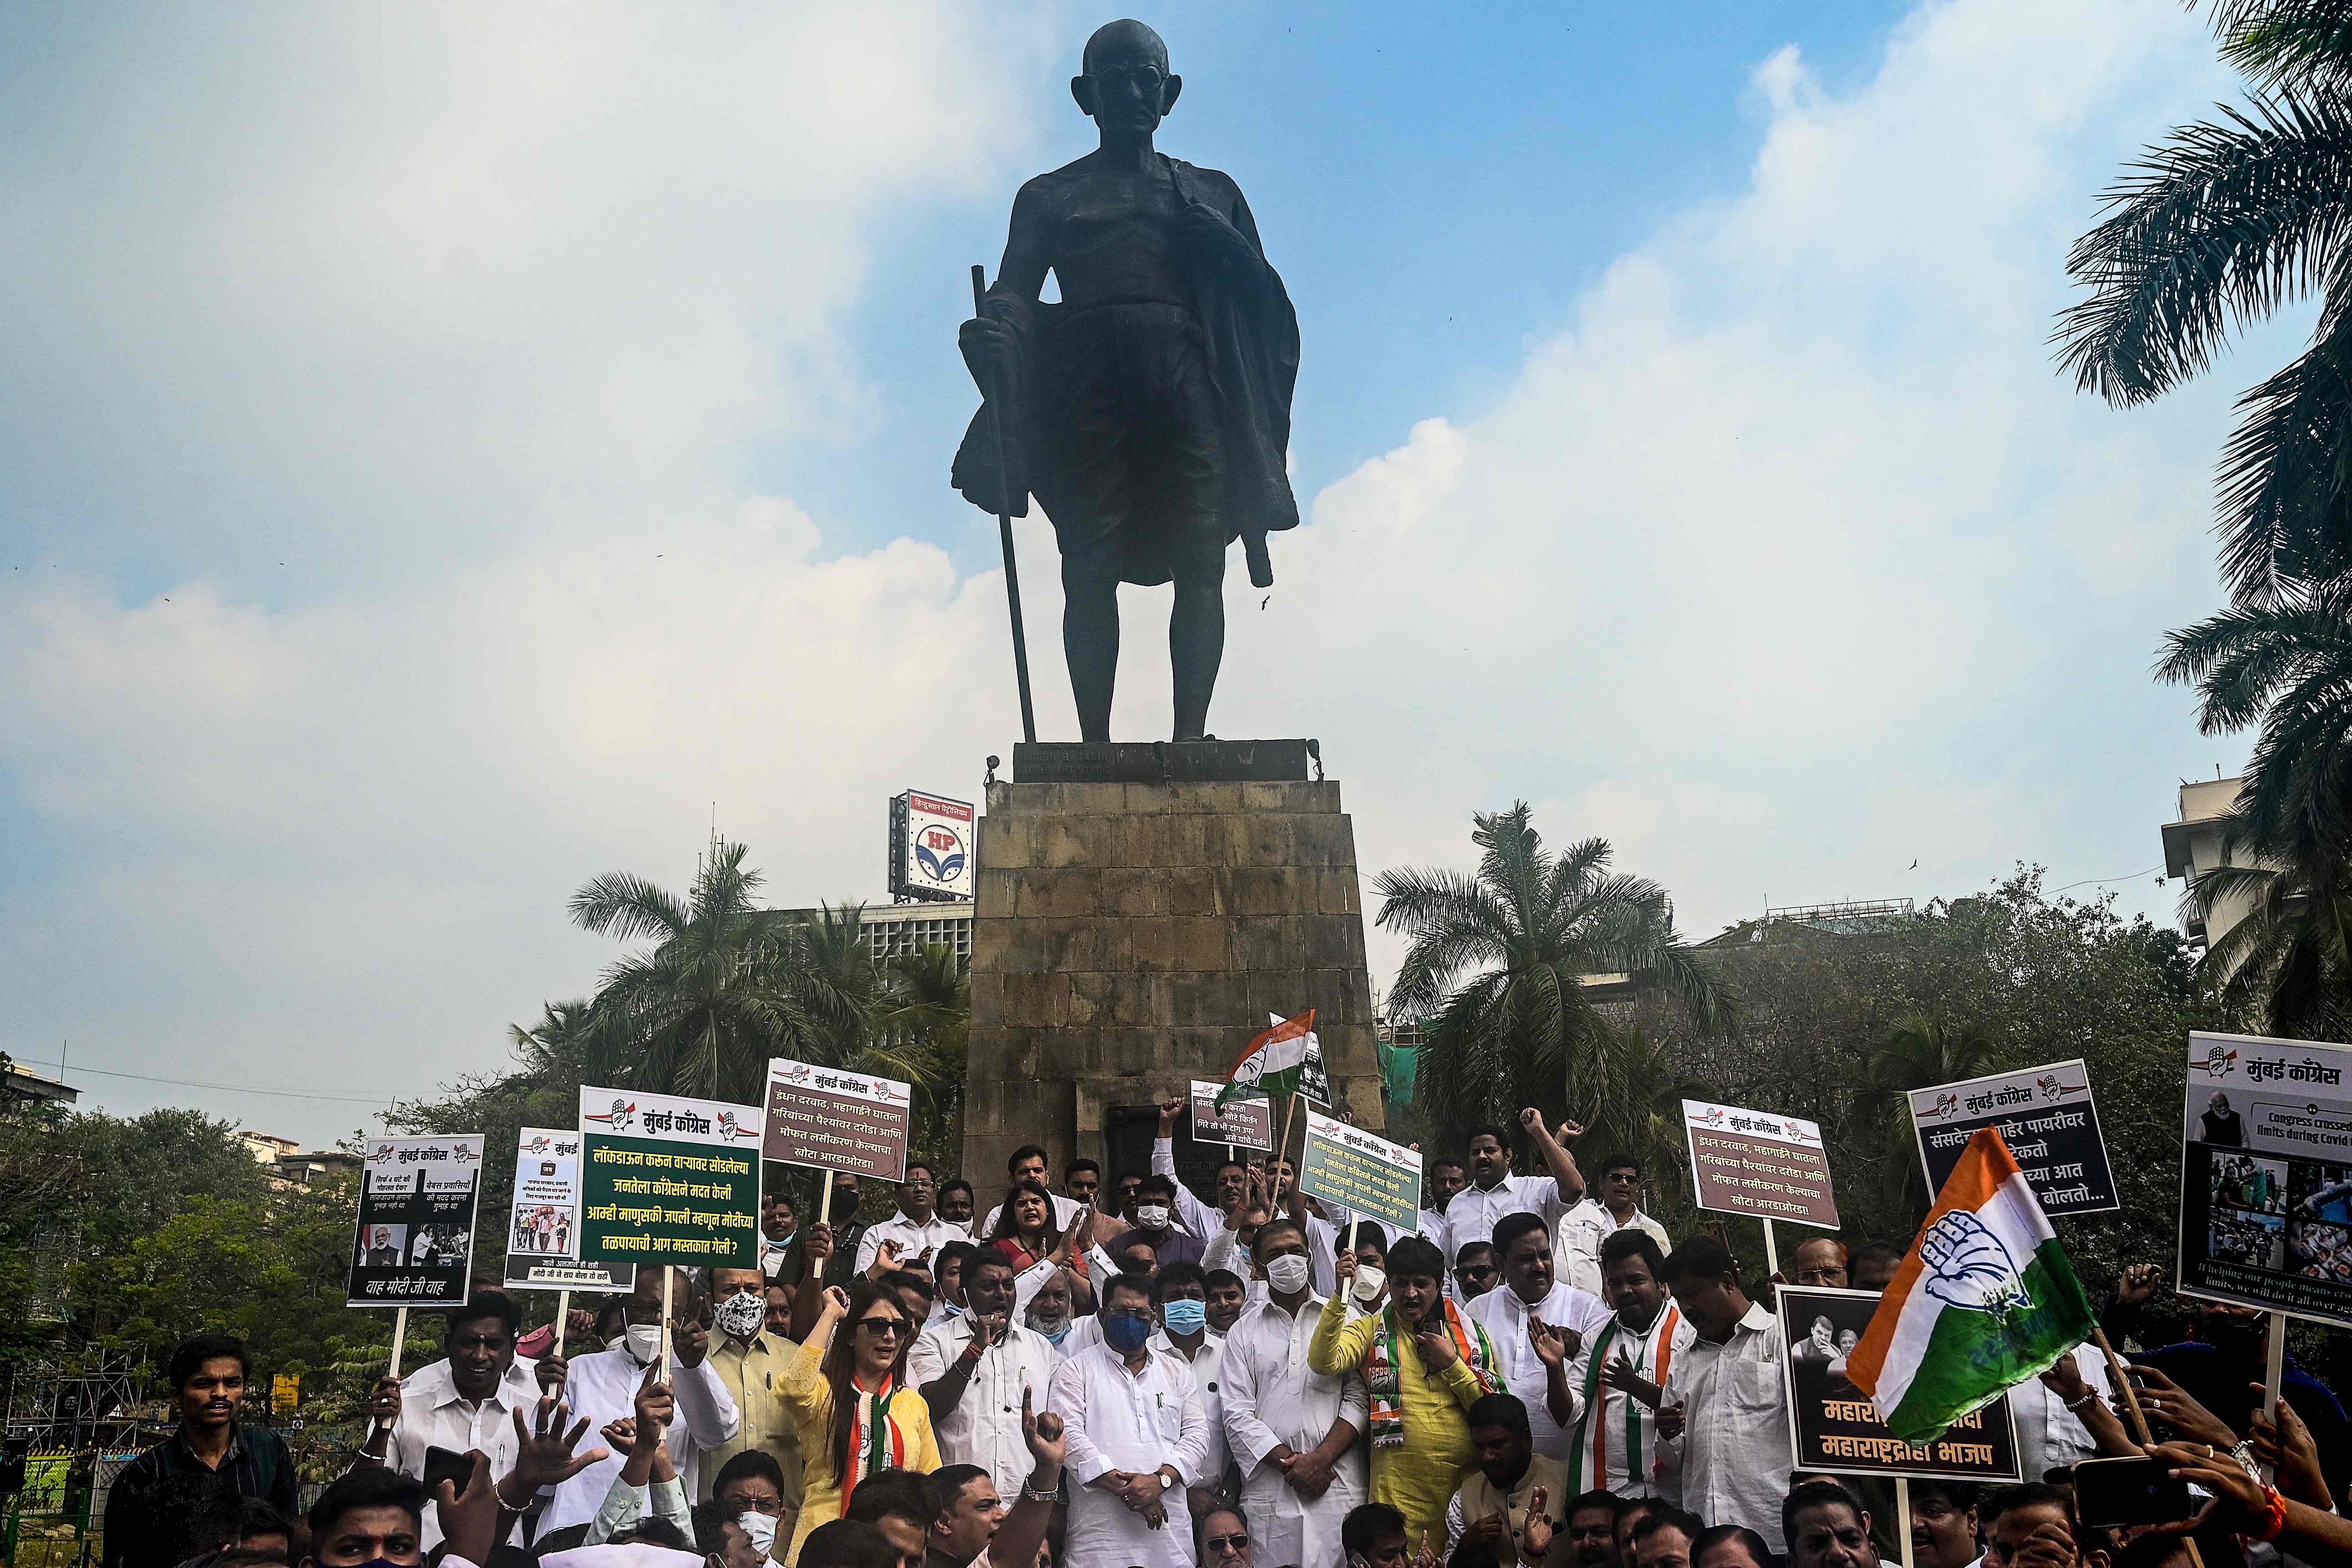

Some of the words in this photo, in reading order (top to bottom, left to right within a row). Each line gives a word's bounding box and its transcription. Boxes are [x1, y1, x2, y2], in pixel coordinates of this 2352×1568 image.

[915, 798, 940, 811] हिन्दुस्तान
[942, 804, 968, 817] पेट्रोलियम
[928, 832, 955, 851] HP
[2246, 1057, 2286, 1082] मुंबई
[2287, 1058, 2342, 1085] काँग्रेस
[815, 1074, 838, 1088] मुंबई
[840, 1077, 868, 1094] काँग्रेस
[776, 1089, 796, 1103] इंधन
[799, 1095, 830, 1110] दरवाढ,
[832, 1101, 871, 1116] महागाईने
[873, 1110, 902, 1123] घातला
[1229, 1104, 1246, 1113] करतो
[1964, 1090, 1994, 1115] मुंबई
[1995, 1085, 2032, 1107] काँग्रेस
[643, 1109, 672, 1134] मुंबई
[674, 1109, 710, 1134] काँग्रेस
[772, 1107, 814, 1124] गरिबांच्या
[816, 1113, 851, 1130] पैश्यांवर
[853, 1122, 877, 1134] दरोडा
[879, 1128, 902, 1140] आणि
[1197, 1119, 1209, 1128] गिरे
[1210, 1121, 1218, 1129] तो
[1220, 1122, 1227, 1131] भी
[1229, 1124, 1241, 1132] टांग
[1224, 1112, 1238, 1121] खोटे
[1729, 1115, 1753, 1131] मुंबई
[1754, 1118, 1781, 1135] काँग्रेस
[2027, 1111, 2085, 1133] पायरीवर
[2269, 1113, 2312, 1126] Congress
[780, 1125, 808, 1140] मोफत
[810, 1132, 853, 1147] लसीकरण
[855, 1138, 891, 1155] केल्याचा
[1224, 1134, 1236, 1142] असे
[1238, 1135, 1251, 1144] यांचे
[1252, 1138, 1267, 1147] वर्तन
[1343, 1133, 1362, 1146] मुंबई
[1364, 1140, 1387, 1156] काँग्रेस
[2257, 1124, 2284, 1137] limits
[2287, 1128, 2319, 1144] during
[2321, 1133, 2348, 1146] Covid
[398, 1148, 420, 1164] मुंबई
[420, 1145, 448, 1160] काँग्रेस
[555, 1142, 578, 1156] मुंबई
[593, 1145, 644, 1165] लॉकडाऊन
[645, 1153, 673, 1168] करून
[709, 1155, 749, 1175] सोडलेल्या
[794, 1146, 818, 1159] खोटा
[820, 1151, 874, 1169] आरडाओरडा!
[1312, 1139, 1343, 1157] लॉकडाऊन
[1344, 1151, 1362, 1164] करून
[1698, 1134, 1719, 1147] इंधन
[1720, 1139, 1752, 1154] दरवाढ,
[1753, 1144, 1791, 1160] महागाईने
[1792, 1152, 1820, 1165] घातला
[1323, 1157, 1347, 1172] जनतेला
[1371, 1175, 1386, 1187] मदत
[1699, 1153, 1740, 1169] गरिबांच्या
[1742, 1158, 1778, 1174] पैश्यांवर
[1778, 1166, 1802, 1178] दरोडा
[1804, 1170, 1827, 1183] आणि
[2053, 1163, 2083, 1179] आत
[426, 1180, 442, 1190] बेबस
[443, 1180, 471, 1190] प्रवासियों
[613, 1175, 651, 1195] जनतेला
[652, 1175, 689, 1197] काँग्रेसने
[690, 1184, 712, 1199] मदत
[712, 1182, 732, 1200] केली
[1306, 1165, 1325, 1178] आम्ही
[1325, 1172, 1354, 1188] माणुसकी
[1354, 1180, 1372, 1194] जपली
[1372, 1188, 1392, 1203] म्हणून
[1391, 1195, 1415, 1211] मोदींच्या
[1711, 1172, 1739, 1186] मोफत
[1741, 1176, 1784, 1193] लसीकरण
[1785, 1183, 1821, 1200] केल्याचा
[2041, 1183, 2105, 1205] बोलतो...
[427, 1193, 435, 1201] की
[433, 1203, 448, 1212] गुनाह
[1315, 1181, 1345, 1198] तळपायाची
[1345, 1193, 1359, 1203] आग
[1359, 1197, 1385, 1213] मस्तकात
[1385, 1206, 1398, 1219] गेली
[1730, 1194, 1754, 1207] खोटा
[1756, 1199, 1809, 1215] आरडाओरडा!
[587, 1203, 617, 1221] आम्ही
[618, 1205, 662, 1227] माणुसकी
[664, 1207, 690, 1225] जपली
[691, 1212, 720, 1231] म्हणून
[721, 1211, 754, 1229] मोदींच्या
[601, 1233, 650, 1250] तळपायाची
[652, 1238, 672, 1252] आग
[672, 1239, 710, 1254] मस्तकात
[711, 1237, 730, 1255] गेली
[732, 1241, 737, 1255] ?
[534, 1268, 545, 1277] मोदी
[556, 1270, 562, 1278] ने
[589, 1271, 595, 1280] तो
[597, 1272, 608, 1281] सही
[542, 1258, 554, 1266] जाने
[588, 1261, 599, 1269] सही
[366, 1281, 386, 1295] वाह
[387, 1276, 410, 1295] मोदी
[410, 1276, 426, 1295] जी
[426, 1281, 447, 1295] वाह
[2208, 1264, 2242, 1280] helping
[2245, 1274, 2262, 1282] our
[2264, 1277, 2296, 1289] people
[2299, 1284, 2330, 1295] means
[2237, 1284, 2250, 1292] we
[2253, 1287, 2270, 1297] will
[2272, 1291, 2284, 1299] do
[2287, 1293, 2294, 1301] it
[2297, 1296, 2310, 1305] all
[2312, 1300, 2335, 1309] over
[1938, 1442, 1993, 1465] भाजप
